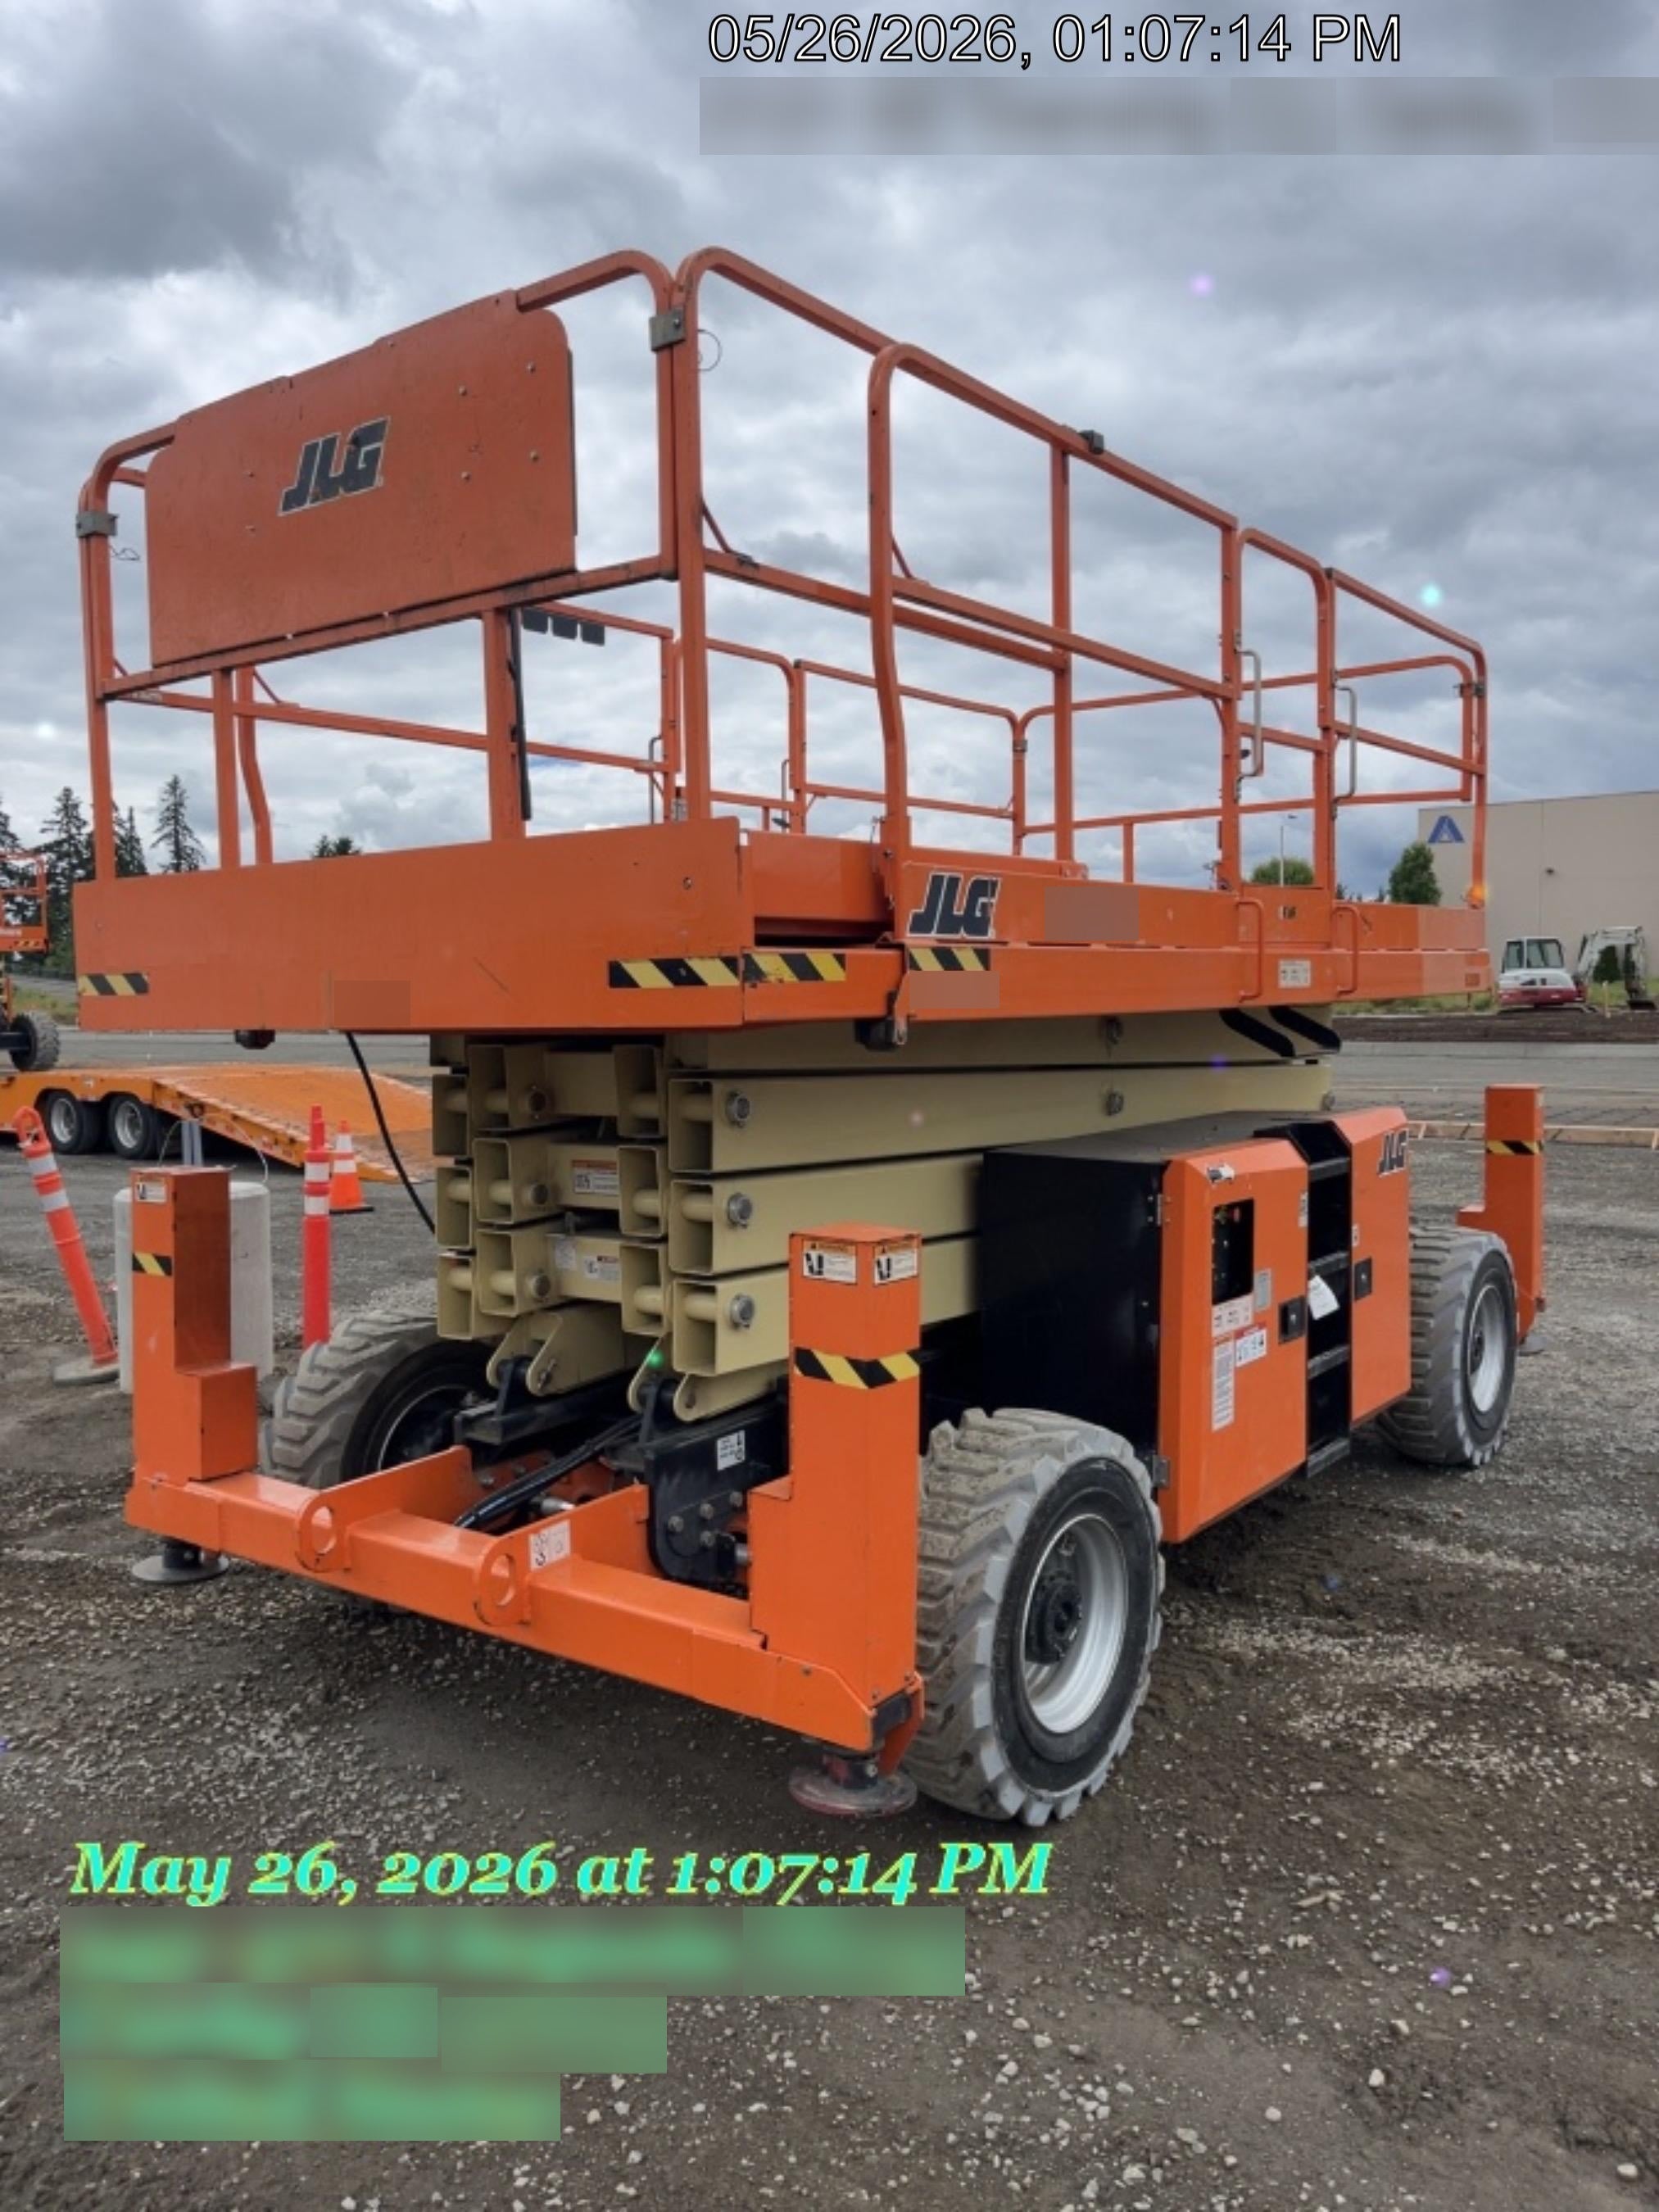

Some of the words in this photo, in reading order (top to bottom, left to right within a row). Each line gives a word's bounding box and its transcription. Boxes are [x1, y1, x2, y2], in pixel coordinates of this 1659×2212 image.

[278, 416, 388, 516] JLG
[907, 873, 1001, 939] JLG
[1377, 1128, 1409, 1177] JLG
